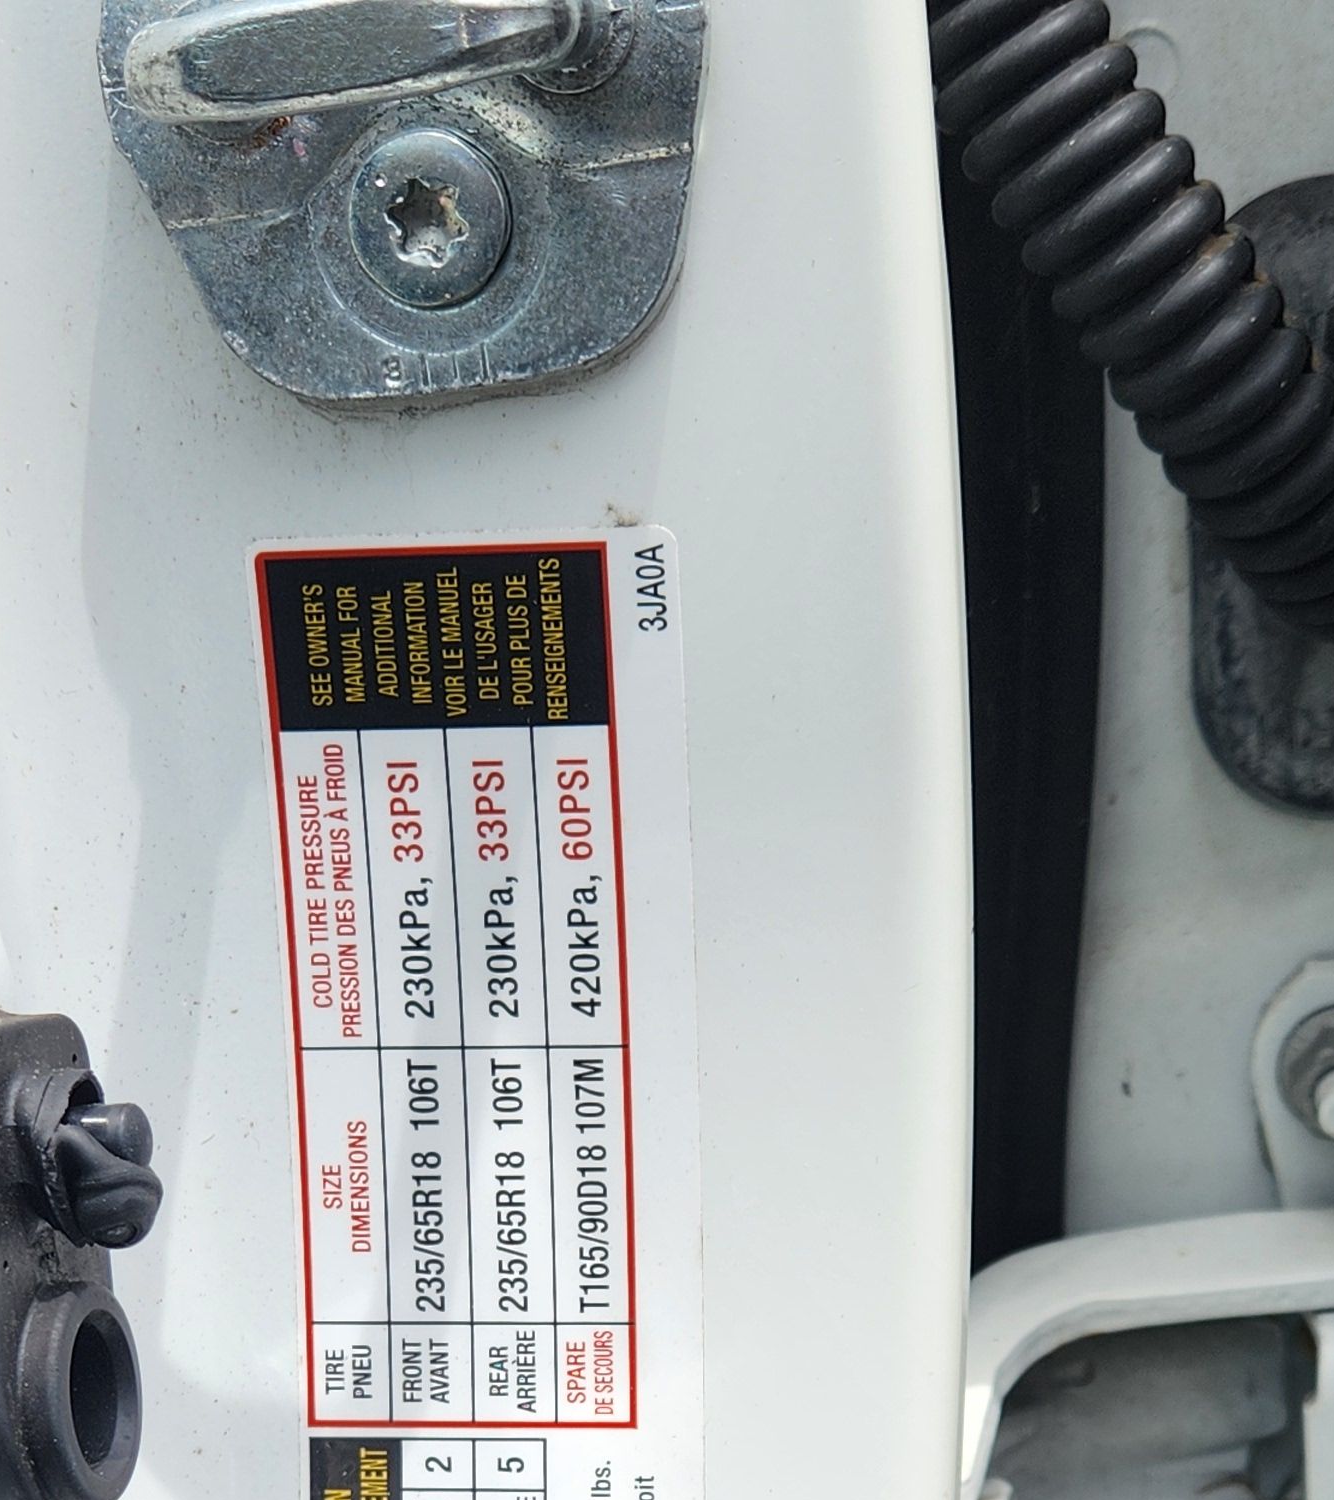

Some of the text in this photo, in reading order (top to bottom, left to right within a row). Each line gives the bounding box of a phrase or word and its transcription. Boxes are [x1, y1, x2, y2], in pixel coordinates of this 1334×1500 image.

[302, 584, 333, 706] SEE OWNER'S
[336, 586, 366, 702] MANUAL FOR
[370, 590, 399, 697] ADDITIONAL
[403, 582, 433, 704] INFORMATION
[436, 567, 467, 717] VOIR LE MANUEL
[471, 582, 500, 700] DE L'USAGER
[505, 574, 534, 705] POUR PLUS DE
[538, 558, 569, 720] RENSEIGNEMENTS
[297, 775, 333, 1009] COLD TIRE PRESSURE
[322, 743, 362, 1038] PRESSION DES PNEUS À FROID
[386, 761, 435, 1019] 230kPa, 33PSI
[471, 760, 519, 1018] 230kPa, 33PSI
[556, 759, 603, 1018] 420kPa, 60PSI
[321, 1164, 343, 1209] SIZE
[346, 1120, 372, 1253] DIMENSIONS
[406, 1058, 446, 1312] 235/65R18 106T
[490, 1057, 529, 1312] 235/65R18 106T
[572, 1058, 610, 1314] T165/90D18 107M
[325, 1349, 346, 1395] TIRE
[351, 1344, 373, 1399] PNEU
[401, 1338, 423, 1403] FRONT
[428, 1338, 450, 1404] AVANT
[488, 1346, 509, 1397] REAR
[511, 1330, 537, 1414] ARRIÈRE
[565, 1341, 586, 1404] SPARE
[593, 1330, 614, 1415] DE SECOURS
[424, 1456, 452, 1473] 2
[497, 1457, 525, 1473] 5
[590, 1460, 612, 1498] lbs.
